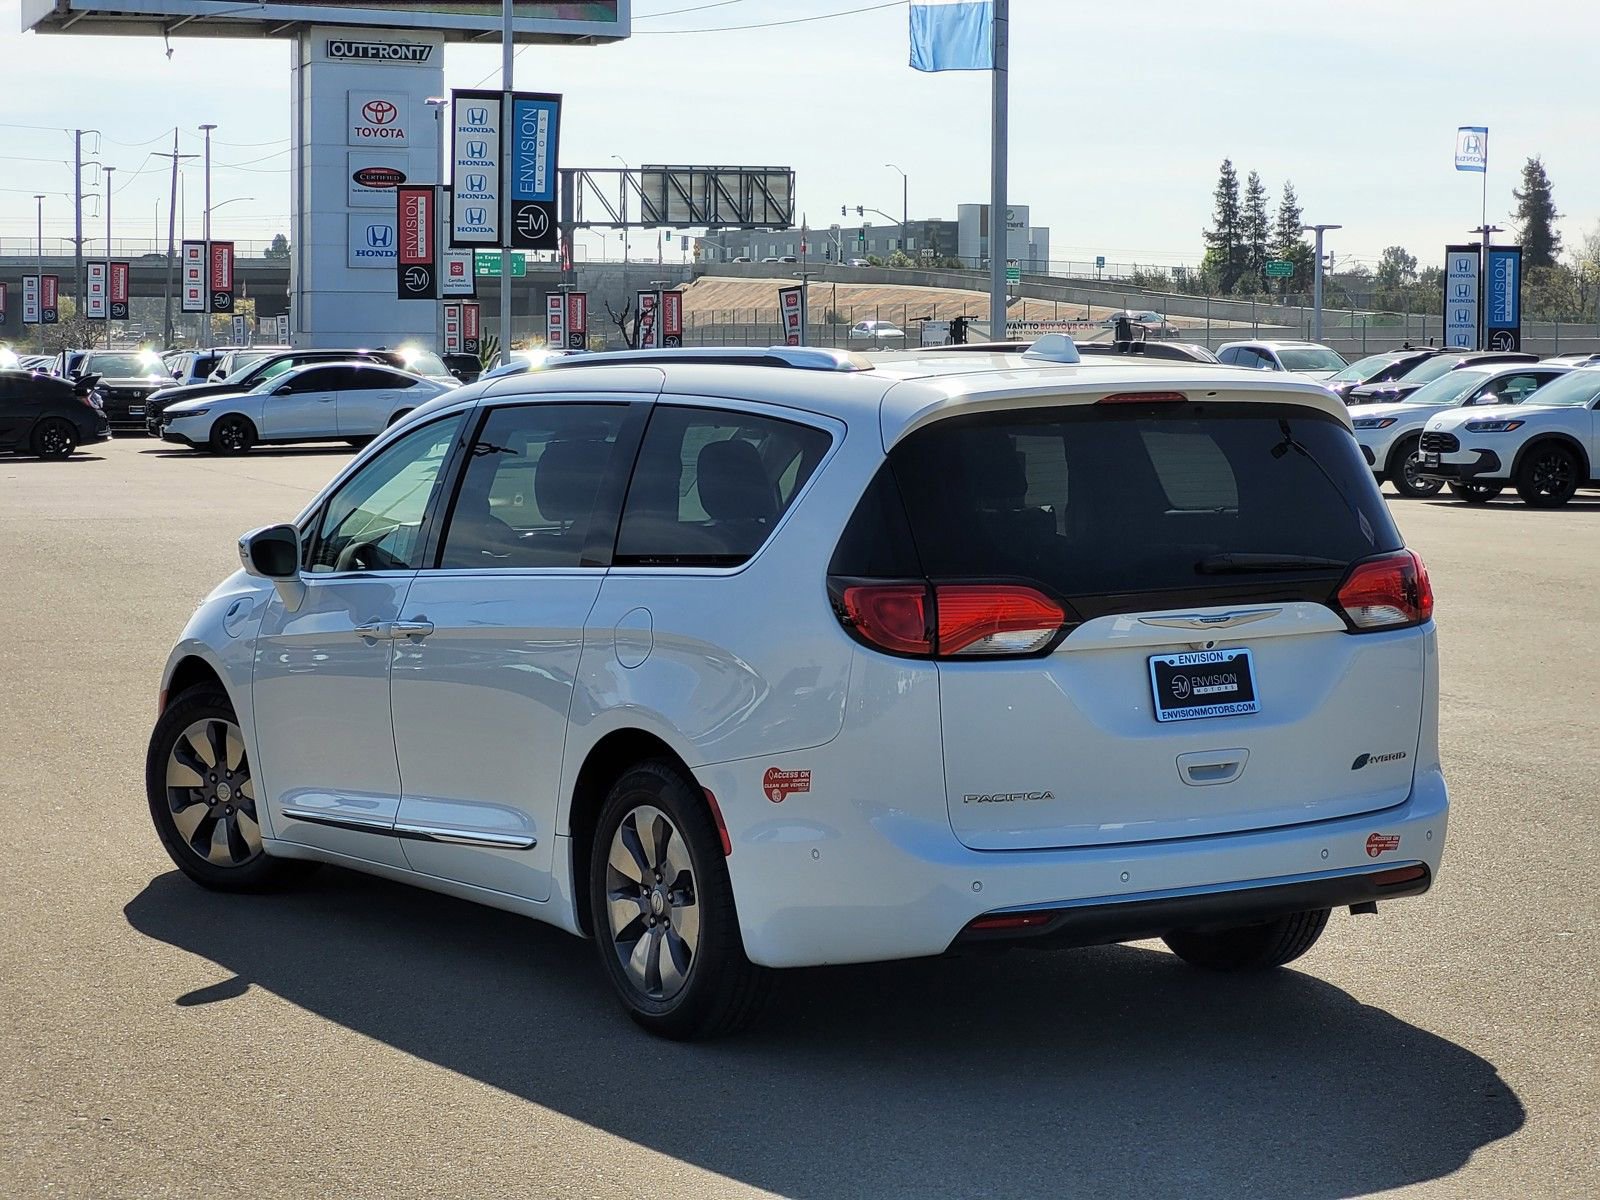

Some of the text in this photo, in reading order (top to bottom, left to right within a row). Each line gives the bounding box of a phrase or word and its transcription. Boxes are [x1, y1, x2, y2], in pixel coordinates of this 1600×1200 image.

[354, 127, 405, 139] TOYOTA
[519, 108, 537, 193] ENVISION
[406, 195, 417, 259] ENVISION
[1494, 258, 1505, 322] ENVISION
[1178, 652, 1224, 665] ENVISION
[1191, 672, 1237, 687] ENVISION
[1196, 684, 1235, 694] MOTORS
[1162, 703, 1256, 720] ENVISIONMOTORS.COM
[964, 790, 1056, 804] PACIFICA
